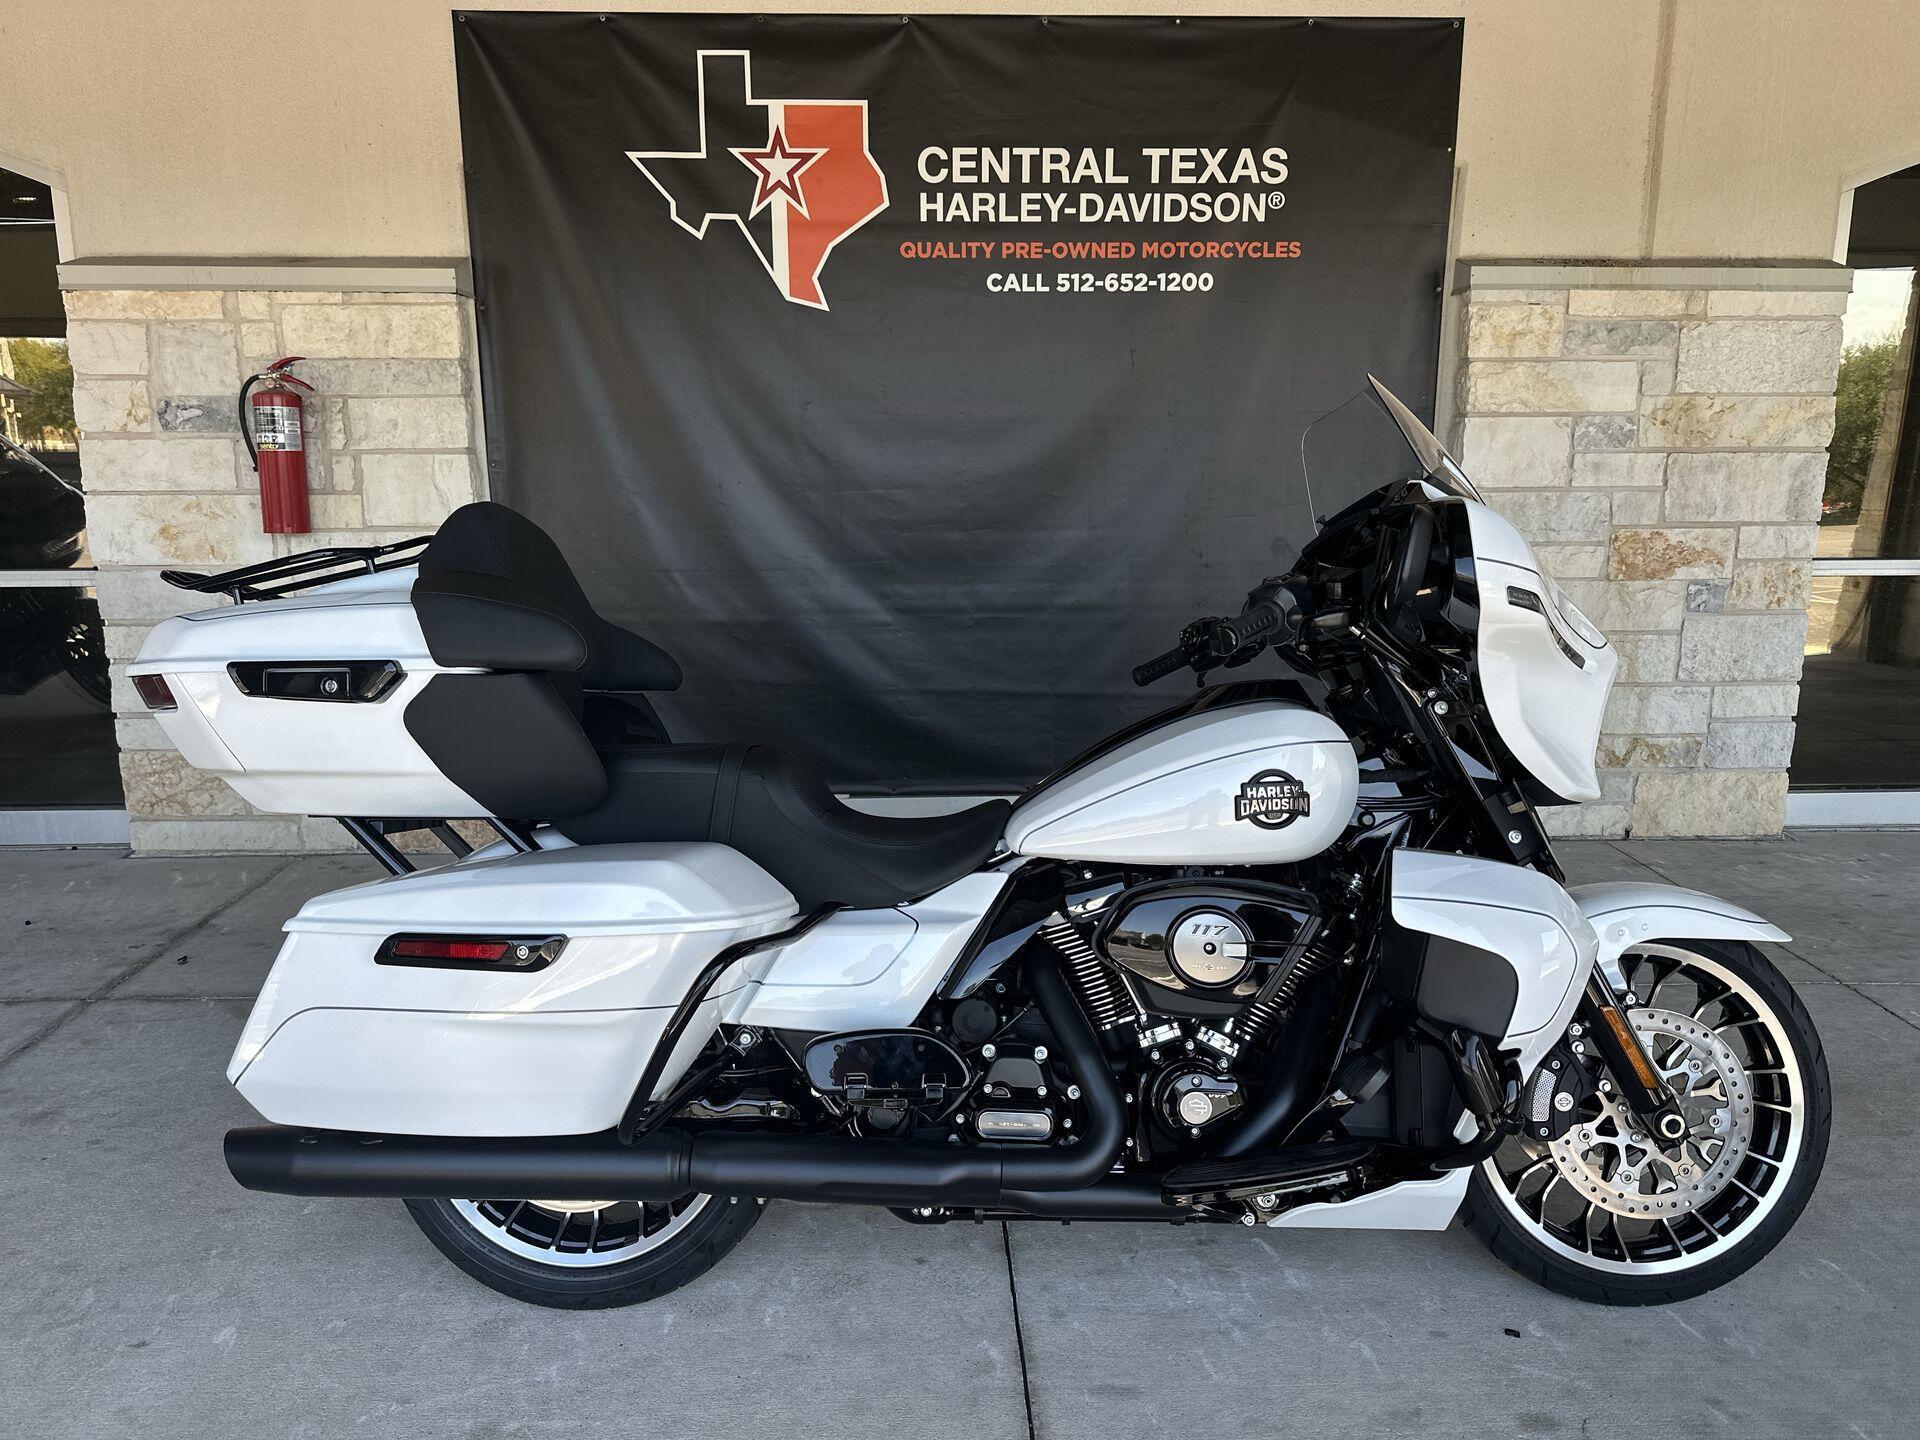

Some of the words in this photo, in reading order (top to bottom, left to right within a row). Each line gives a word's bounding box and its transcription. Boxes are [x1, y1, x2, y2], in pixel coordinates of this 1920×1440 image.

[917, 146, 1129, 184] CENTRAL
[1142, 147, 1289, 184] TEXAS
[900, 241, 996, 260] QUALITY
[1001, 241, 1136, 259] PRE-OWNED
[1141, 241, 1302, 259] MOTORCYCLES
[986, 272, 1050, 293] CALL
[1055, 272, 1214, 293] 512-652-1200
[1240, 797, 1308, 817] DAVIDSON
[1191, 924, 1230, 937] 117
